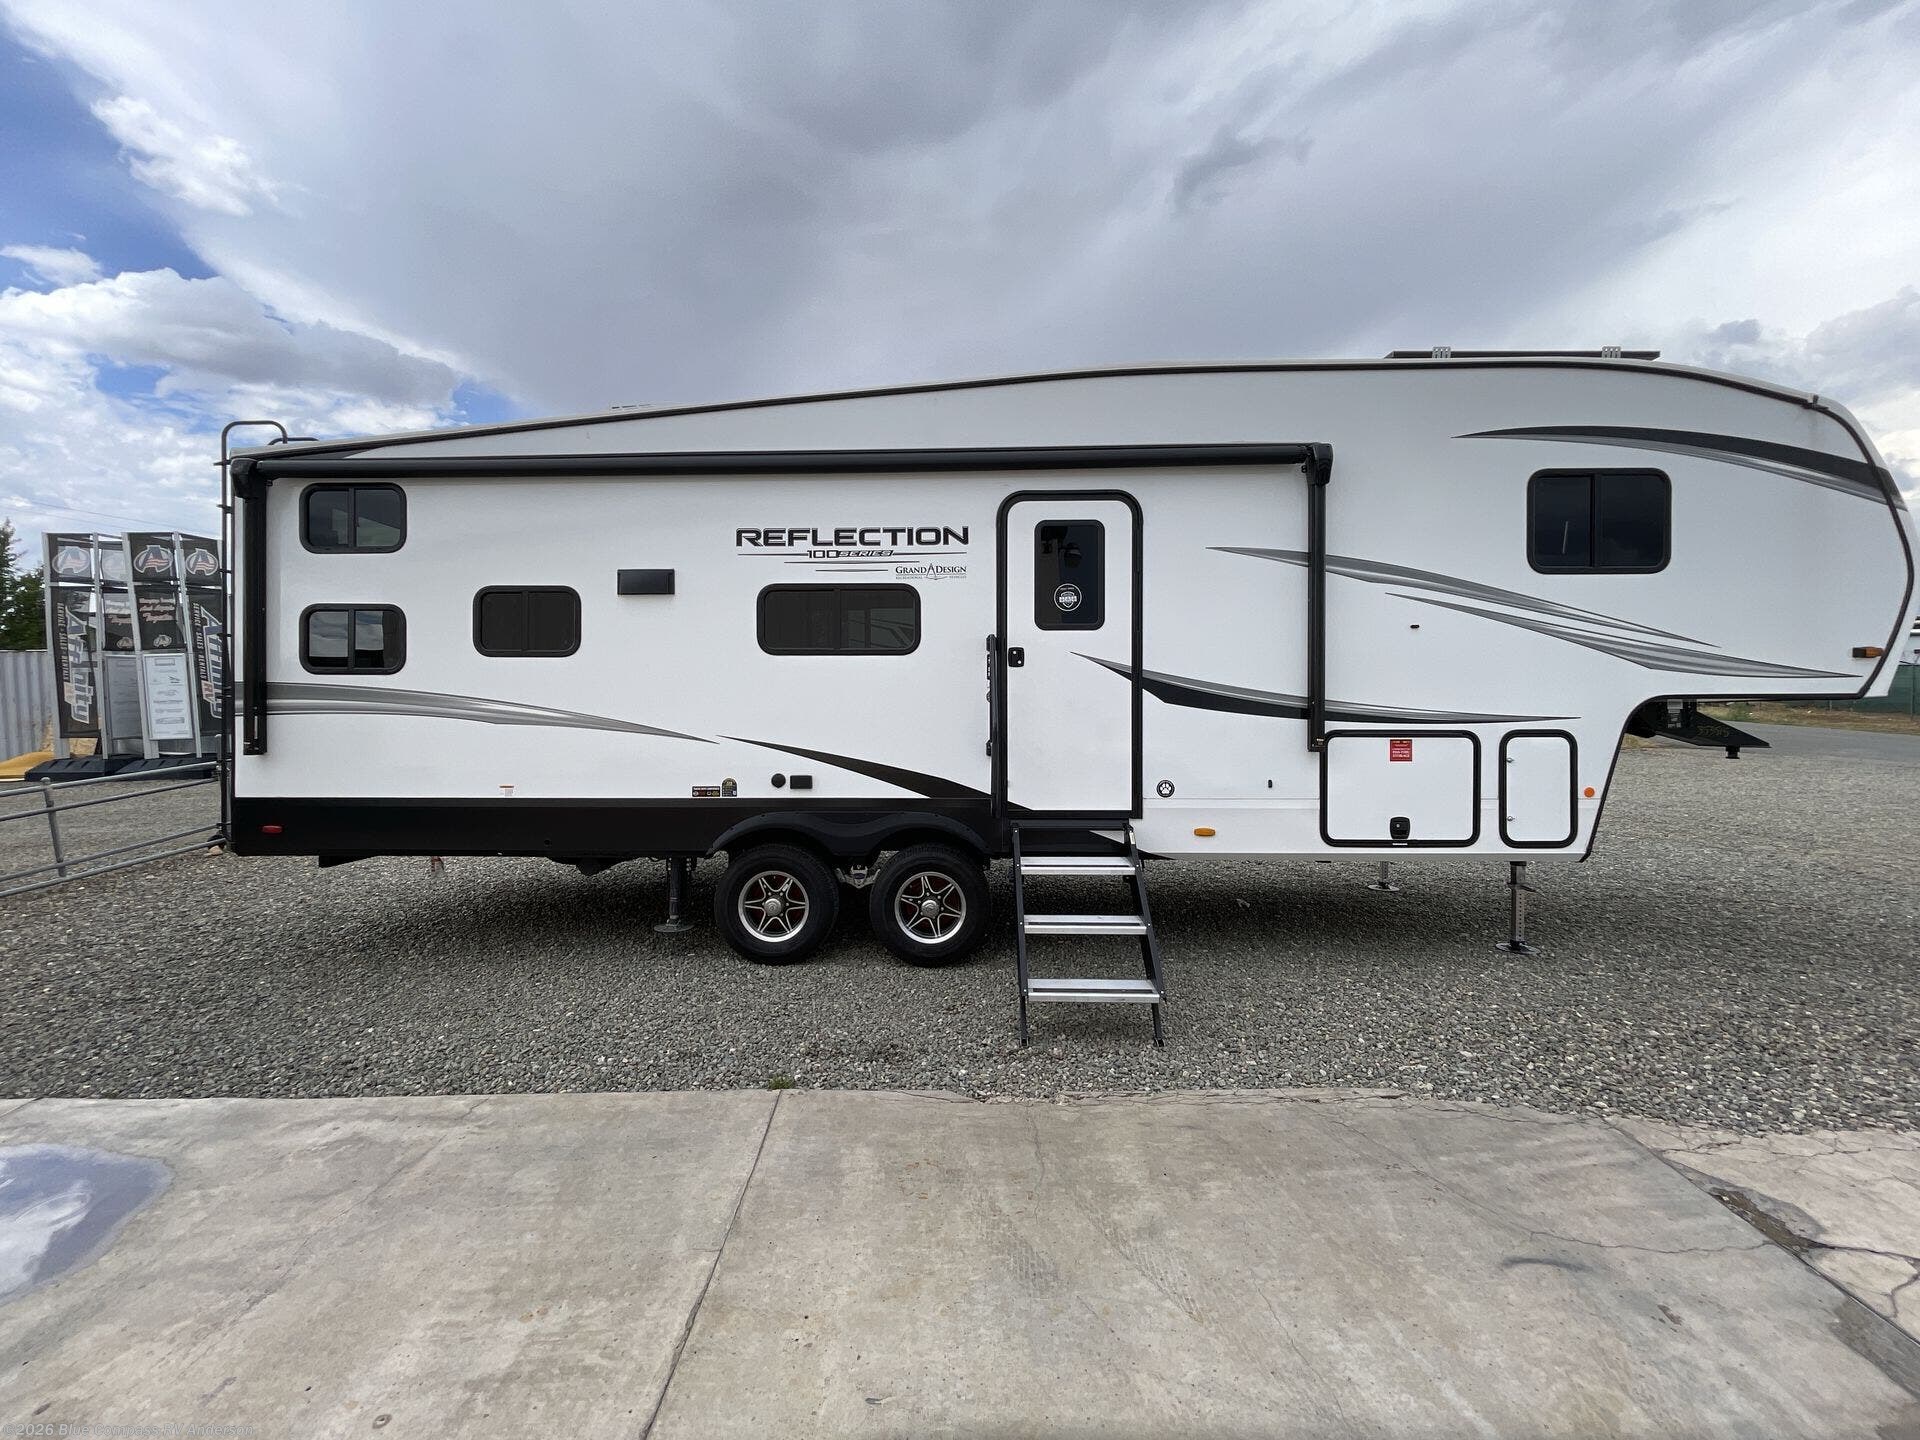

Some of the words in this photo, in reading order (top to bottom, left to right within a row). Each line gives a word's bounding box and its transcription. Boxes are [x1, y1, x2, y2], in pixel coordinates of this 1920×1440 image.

[735, 526, 969, 547] REFLECTION
[895, 565, 927, 574] GRAND
[935, 565, 967, 573] DESIGN
